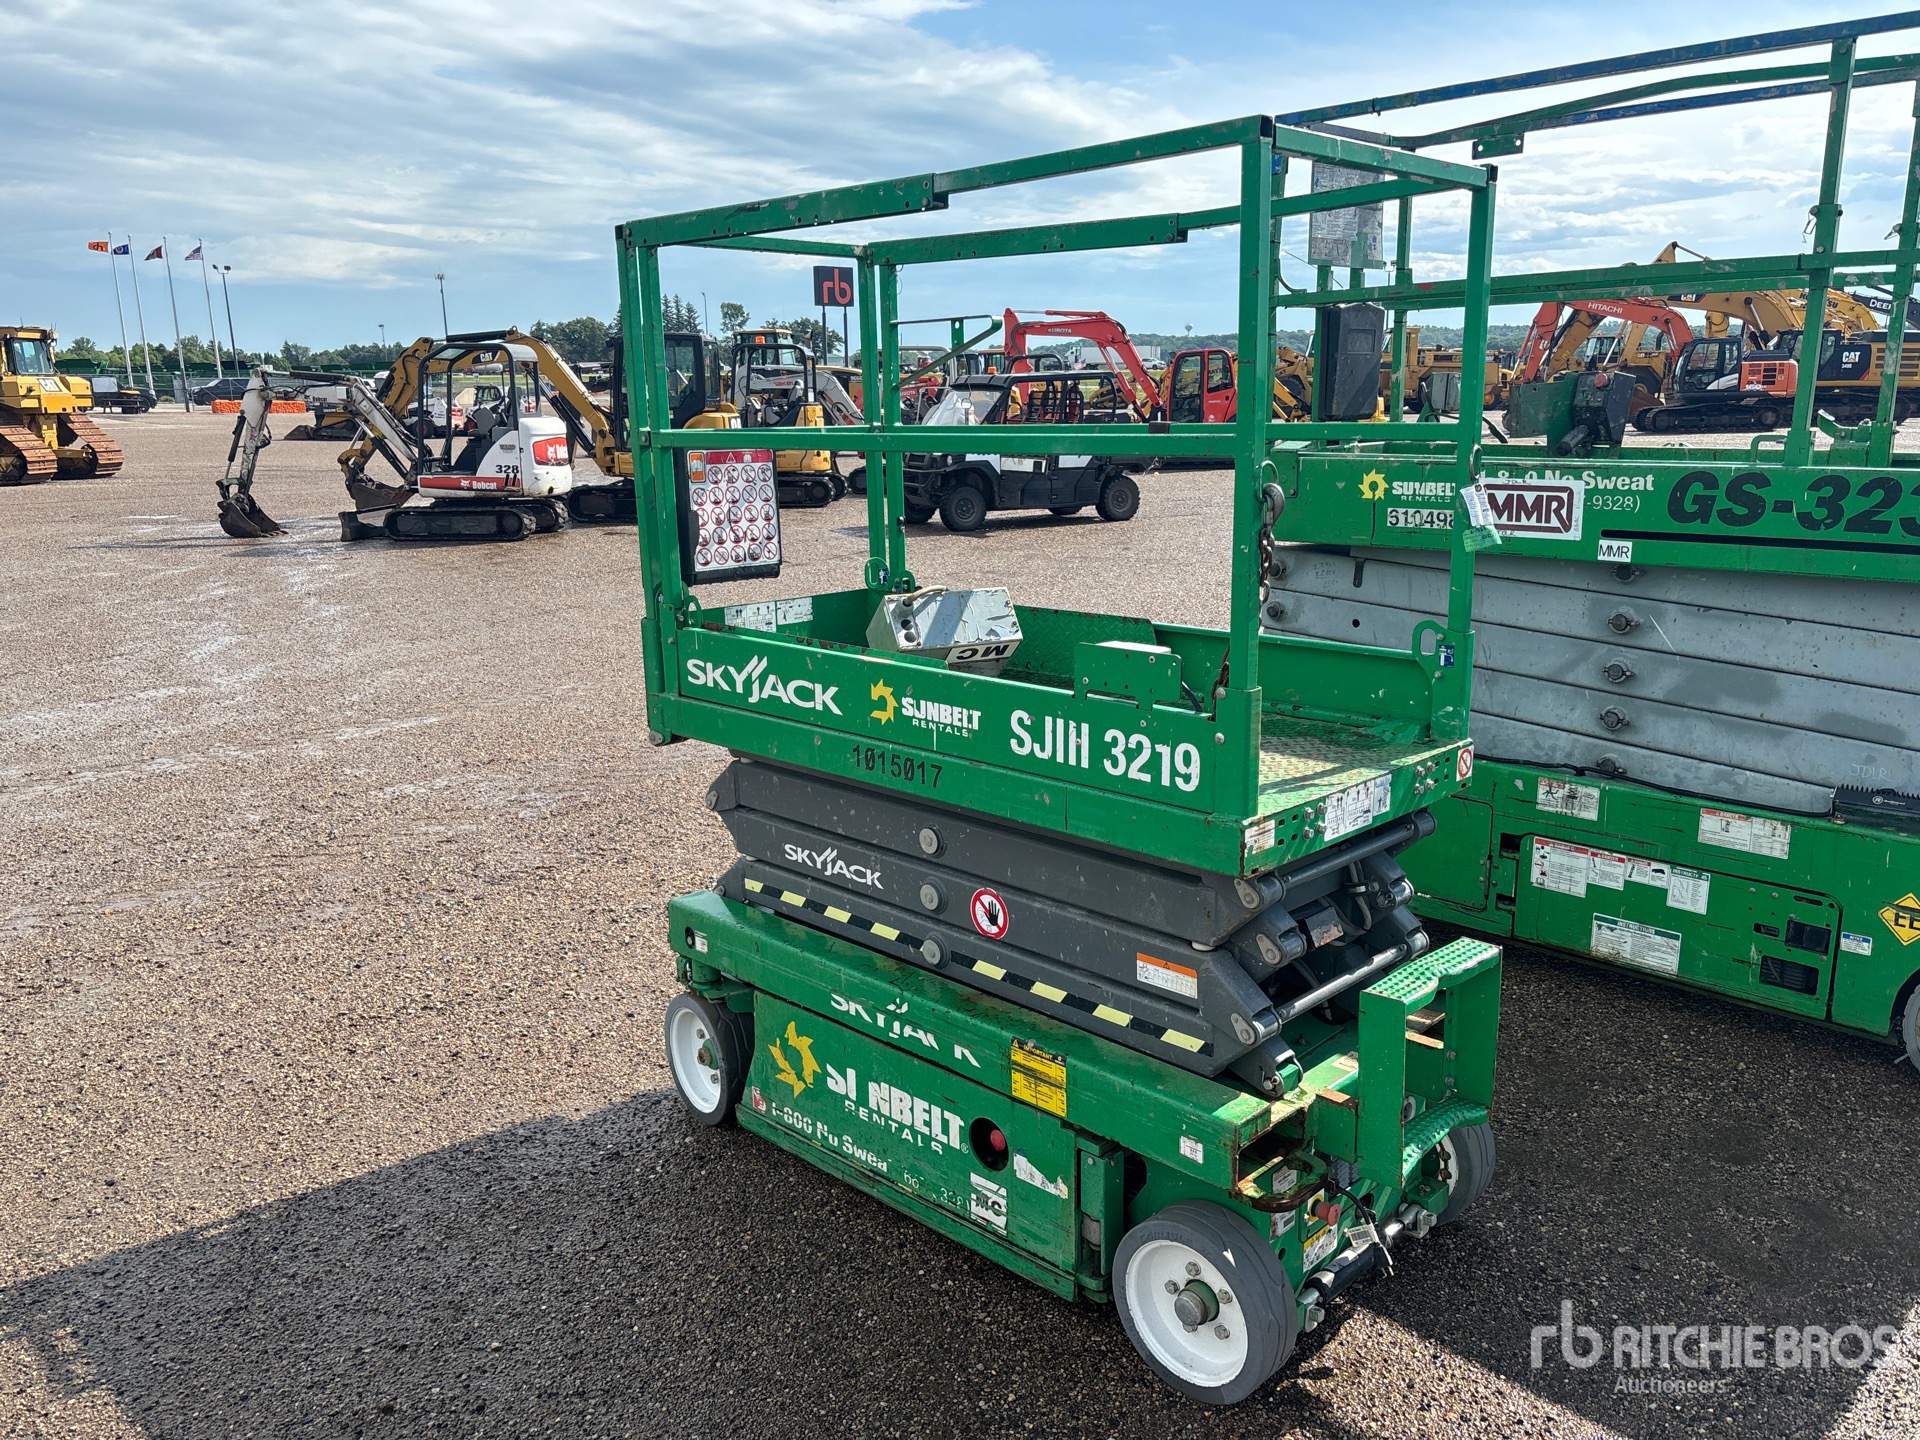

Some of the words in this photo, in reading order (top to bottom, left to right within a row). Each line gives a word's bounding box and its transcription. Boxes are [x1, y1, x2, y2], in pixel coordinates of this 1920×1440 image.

[823, 268, 851, 304] rb
[1588, 302, 1623, 314] HITACHI
[480, 352, 493, 362] CAT
[1842, 351, 1861, 363] CAT
[495, 464, 520, 474] 328
[472, 480, 497, 490] Bobcat
[1582, 470, 1655, 491] Sweat
[1401, 495, 1451, 503] RENTALS
[1487, 493, 1566, 524] MMR
[1583, 494, 1641, 513] -9328)
[1599, 545, 1630, 558] MMR
[956, 644, 1010, 660] MC
[686, 655, 844, 716] SKYJACK
[901, 696, 981, 731] SUNBELT
[912, 718, 969, 738] RENTALS
[1103, 728, 1200, 792] 3219
[784, 843, 884, 890] SKYJACK
[1672, 868, 1708, 881] INSTRUCTINS
[1617, 920, 1655, 935] INSTRUCTIONS
[830, 993, 981, 1069] SKYJAK
[1023, 1044, 1053, 1060] IMPORTANT
[844, 1099, 943, 1155] RENTALS
[842, 1134, 892, 1173] Swea
